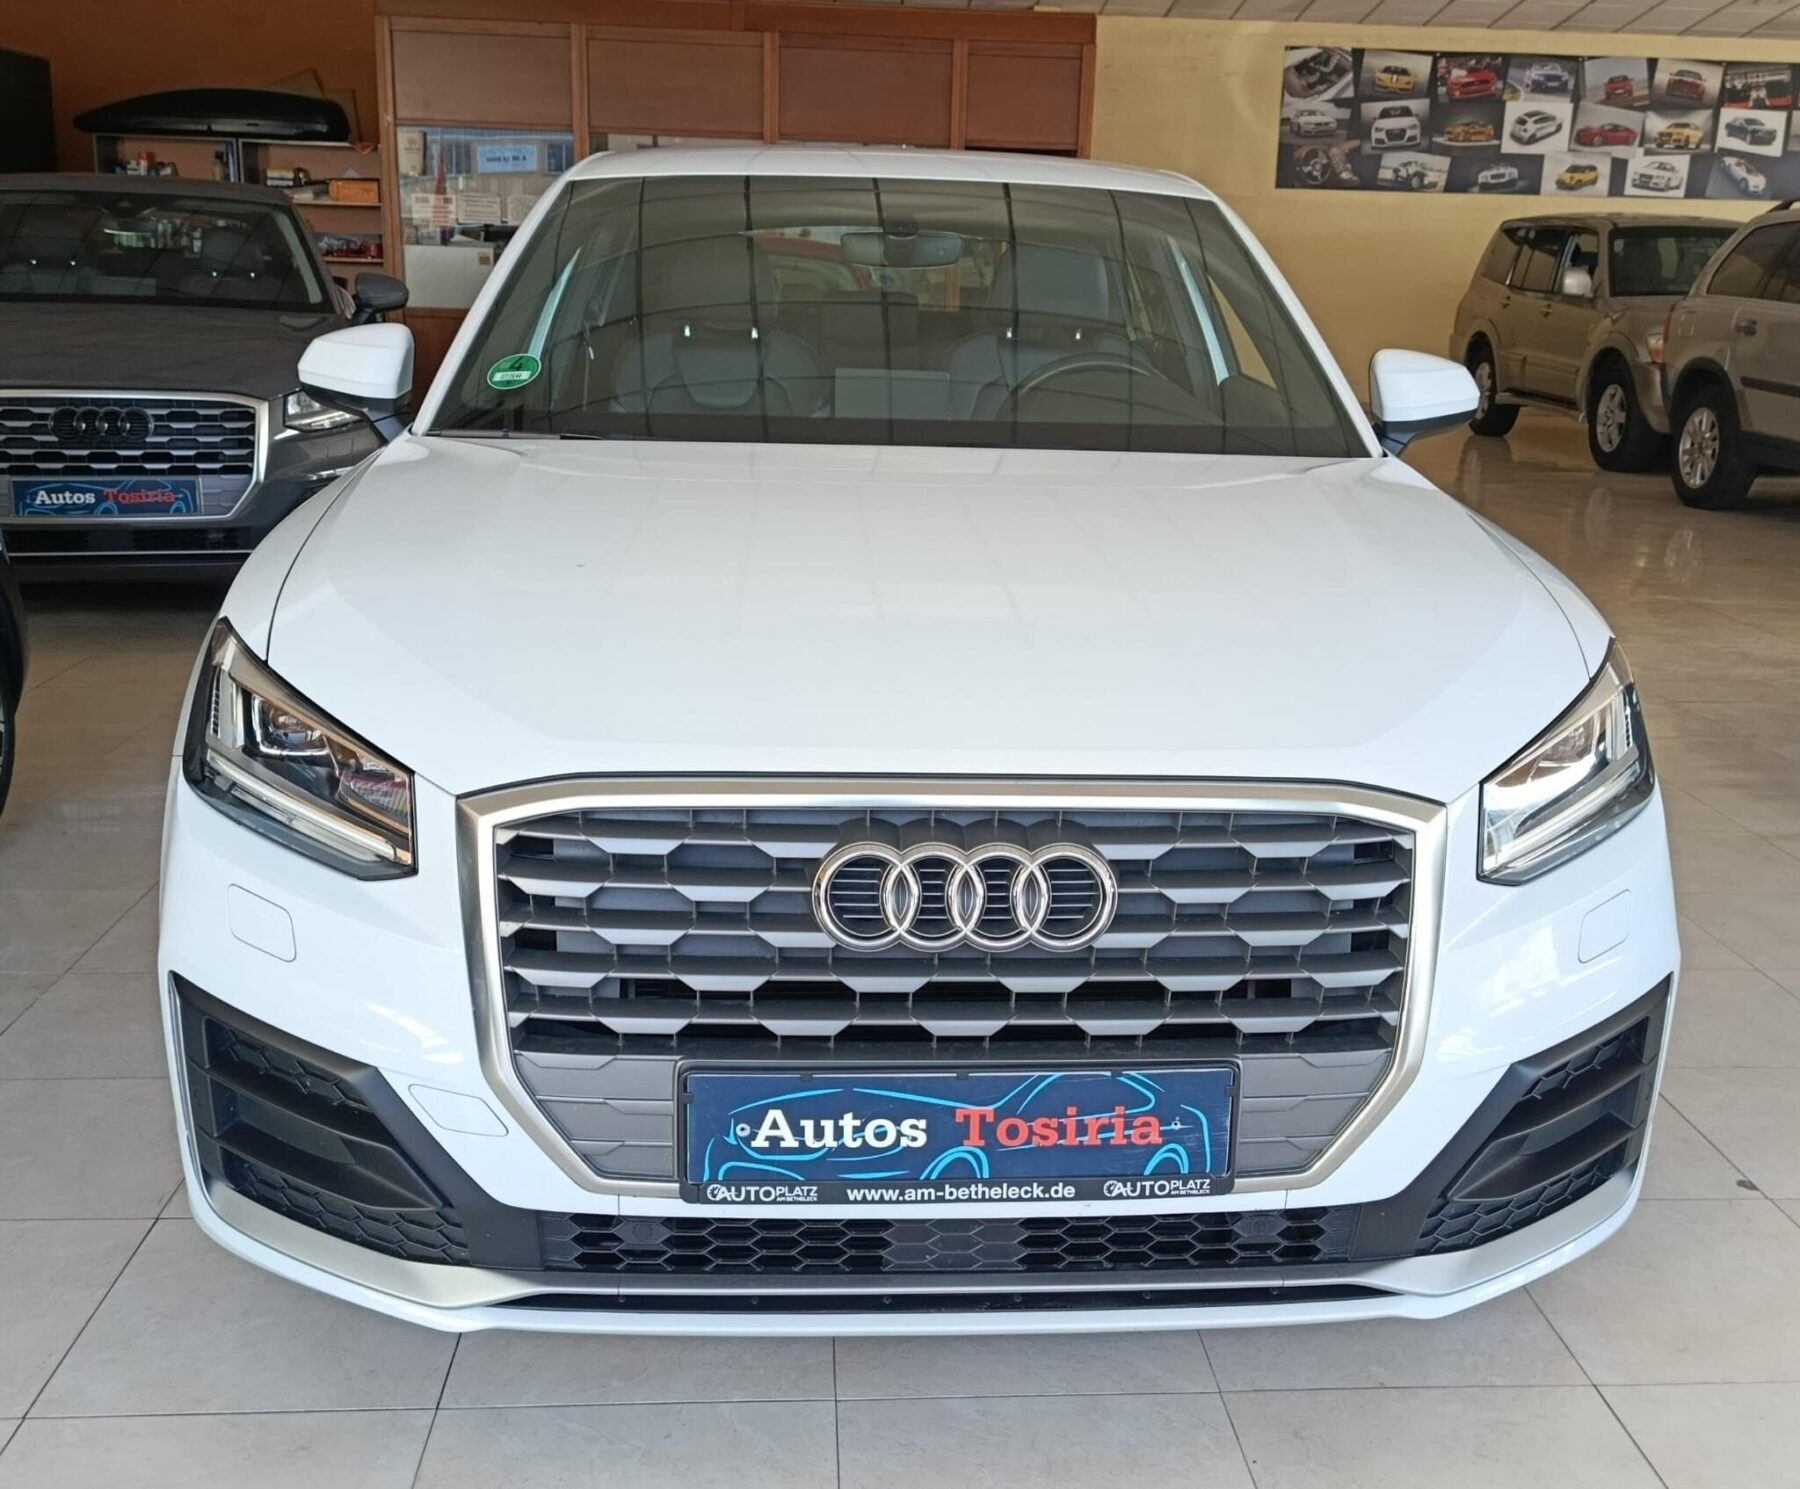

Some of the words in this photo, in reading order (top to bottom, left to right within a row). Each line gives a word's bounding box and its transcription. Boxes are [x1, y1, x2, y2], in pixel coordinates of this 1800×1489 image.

[508, 355, 524, 371] 4
[34, 490, 96, 504] Autos
[103, 488, 176, 504] Tosiria
[750, 1108, 928, 1149] Autos
[955, 1106, 1163, 1147] Tosiria
[846, 1182, 1076, 1201] www.am-betheleck.de
